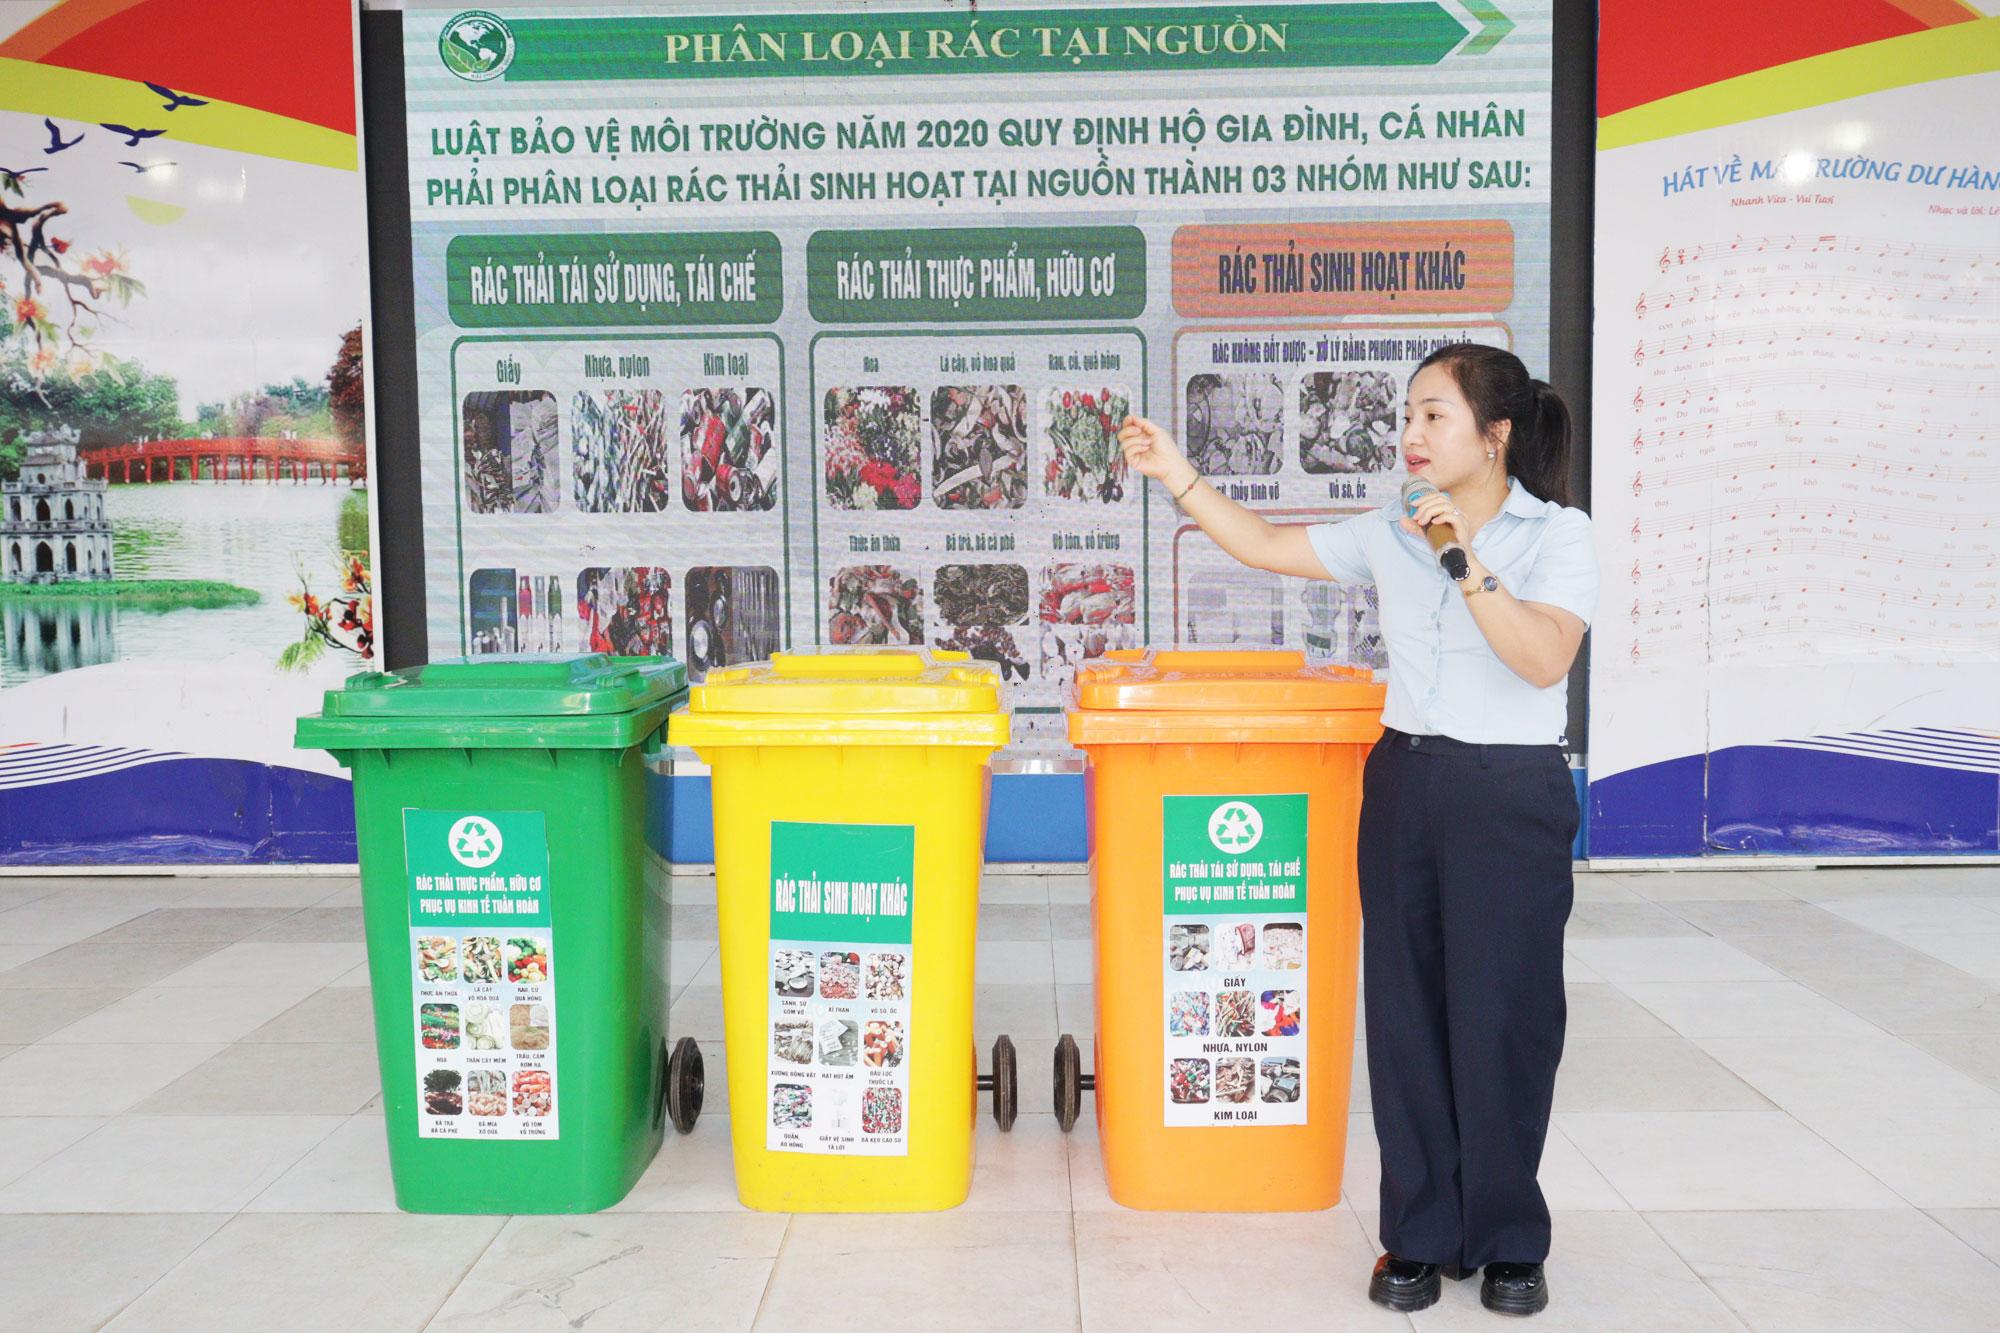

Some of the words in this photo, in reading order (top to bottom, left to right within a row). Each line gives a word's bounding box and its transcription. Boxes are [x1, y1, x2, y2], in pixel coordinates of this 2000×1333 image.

[664, 23, 787, 64] PHÂN
[800, 30, 913, 69] LOẠI
[925, 20, 1020, 60] RÁC
[1032, 27, 1110, 65] TẠI
[1123, 15, 1289, 55] NGUỒN
[431, 119, 500, 163] LUẬT
[511, 116, 575, 154] BẢO
[585, 117, 620, 161] VỆ
[631, 117, 689, 153] MÔI
[700, 114, 826, 151] TRƯỜNG
[837, 114, 905, 150] NĂM
[917, 119, 988, 148] 2020
[999, 118, 1063, 147] QUY
[1073, 117, 1149, 153] ĐỊNH
[1160, 107, 1206, 151] HỘ
[1216, 113, 1272, 143] GIA
[1283, 104, 1368, 145] ĐÌNH,
[1379, 103, 1426, 140] CÁ
[1437, 101, 1525, 138] NHÂN
[427, 167, 493, 205] PHẢI
[503, 169, 582, 205] PHÂN
[592, 175, 656, 211] LOẠI
[667, 166, 728, 203] RÁC
[736, 163, 800, 201] THẢI
[810, 171, 876, 200] SINH
[887, 170, 965, 207] HOẠT
[973, 169, 1017, 205] TẠI
[1027, 153, 1135, 197] NGUỒN
[1144, 158, 1242, 196] THÀNH
[1253, 164, 1286, 193] 03
[1297, 154, 1387, 192] NHÓM
[1398, 157, 1461, 191] NHƯ
[1468, 160, 1531, 189] SAU:
[1663, 165, 1709, 197] HÁT
[1713, 154, 1742, 185] VỀ
[1814, 154, 1902, 182] RƯỜNG
[1907, 163, 1947, 186] DƯ
[1947, 165, 2000, 191] HÀN
[471, 257, 508, 305] RÁC
[512, 251, 555, 304] THẢI
[559, 256, 588, 304] TÁI
[594, 250, 620, 303] SỬ
[624, 262, 681, 312] DỤNG,
[685, 254, 715, 302] TÁI
[720, 249, 757, 302] CHẾ
[837, 252, 874, 300] RÁC
[880, 246, 921, 299] THẢI
[926, 255, 974, 308] THỰC
[980, 241, 1041, 303] PHẨM,
[1046, 249, 1084, 298] HỮU
[1090, 252, 1116, 297] CƠ
[1219, 245, 1257, 294] RÁC
[1262, 239, 1304, 293] THẢI
[1310, 252, 1355, 292] SINH
[1361, 251, 1410, 300] HOẠT
[1415, 241, 1466, 291] KHÁC
[1212, 338, 1229, 363] RÁC
[1232, 337, 1261, 363] KHÔNG
[1264, 334, 1280, 363] ĐỐT
[1283, 339, 1307, 367] ĐƯỢC
[1316, 334, 1328, 362] XỬ
[1330, 335, 1341, 362] LÝ
[1342, 332, 1366, 362] BẰNG
[1368, 339, 1403, 362] PHƯƠNG
[496, 353, 521, 385] Giấy
[584, 353, 616, 382] Nhựa,
[618, 353, 650, 379] nylon
[703, 352, 725, 376] Kim
[728, 352, 749, 381] loại
[416, 873, 433, 891] RÁC
[434, 872, 453, 891] THẢI
[455, 875, 478, 894] THỰC
[479, 871, 508, 892] PHẨM,
[509, 874, 527, 891] HỮU
[529, 875, 542, 891] CƠ
[1170, 860, 1187, 879] RÁC
[1189, 859, 1208, 878] THẢI
[1210, 860, 1224, 878] TÁI
[1226, 859, 1239, 878] SỬ
[1240, 862, 1266, 881] DỤNG,
[1268, 859, 1282, 877] TÁI
[1284, 856, 1300, 877] CHẾ
[420, 898, 443, 917] PHỤC
[444, 898, 456, 917] VỤ
[458, 899, 479, 914] KINH
[480, 894, 491, 914] TẾ
[492, 893, 514, 914] TUẦN
[516, 896, 539, 914] HOÀN
[775, 871, 796, 913] RÁC
[798, 870, 821, 914] THẢI
[824, 881, 849, 915] SINH
[851, 881, 878, 923] HOẠT
[880, 876, 907, 917] KHÁC
[1174, 886, 1197, 904] PHỤC
[1199, 886, 1211, 904] VỤ
[1213, 885, 1234, 901] KINH
[1236, 880, 1246, 901] TẾ
[1248, 879, 1270, 900] TUẦN
[1272, 881, 1295, 899] HOÀN
[1203, 1042, 1233, 1055] NHỰA,
[1236, 1042, 1268, 1053] NYLON
[1214, 1110, 1233, 1121] KIM
[1236, 1110, 1258, 1123] LOẠI
